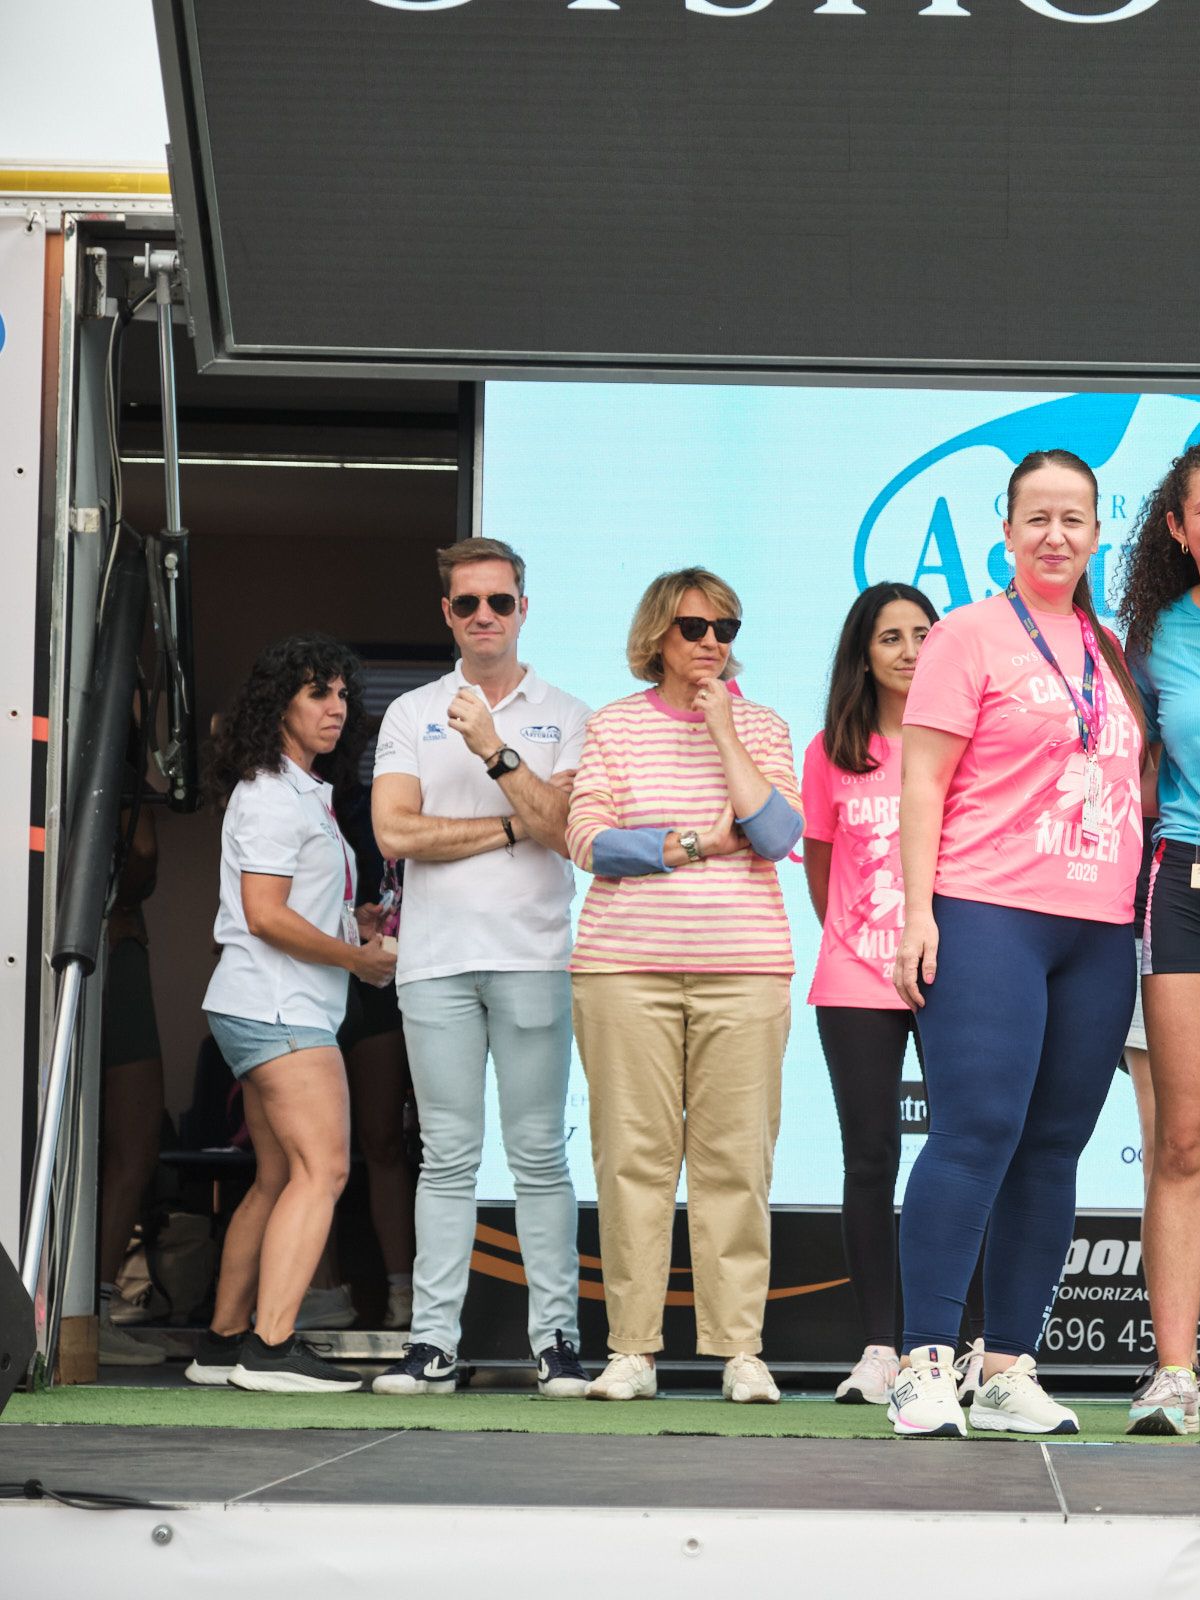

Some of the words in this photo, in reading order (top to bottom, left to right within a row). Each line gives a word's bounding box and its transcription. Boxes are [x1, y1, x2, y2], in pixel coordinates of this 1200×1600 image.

[841, 772, 886, 786] OYSHO
[1067, 861, 1098, 883] 2026
[1045, 1317, 1106, 1351] 696
[1117, 1319, 1156, 1353] 45
